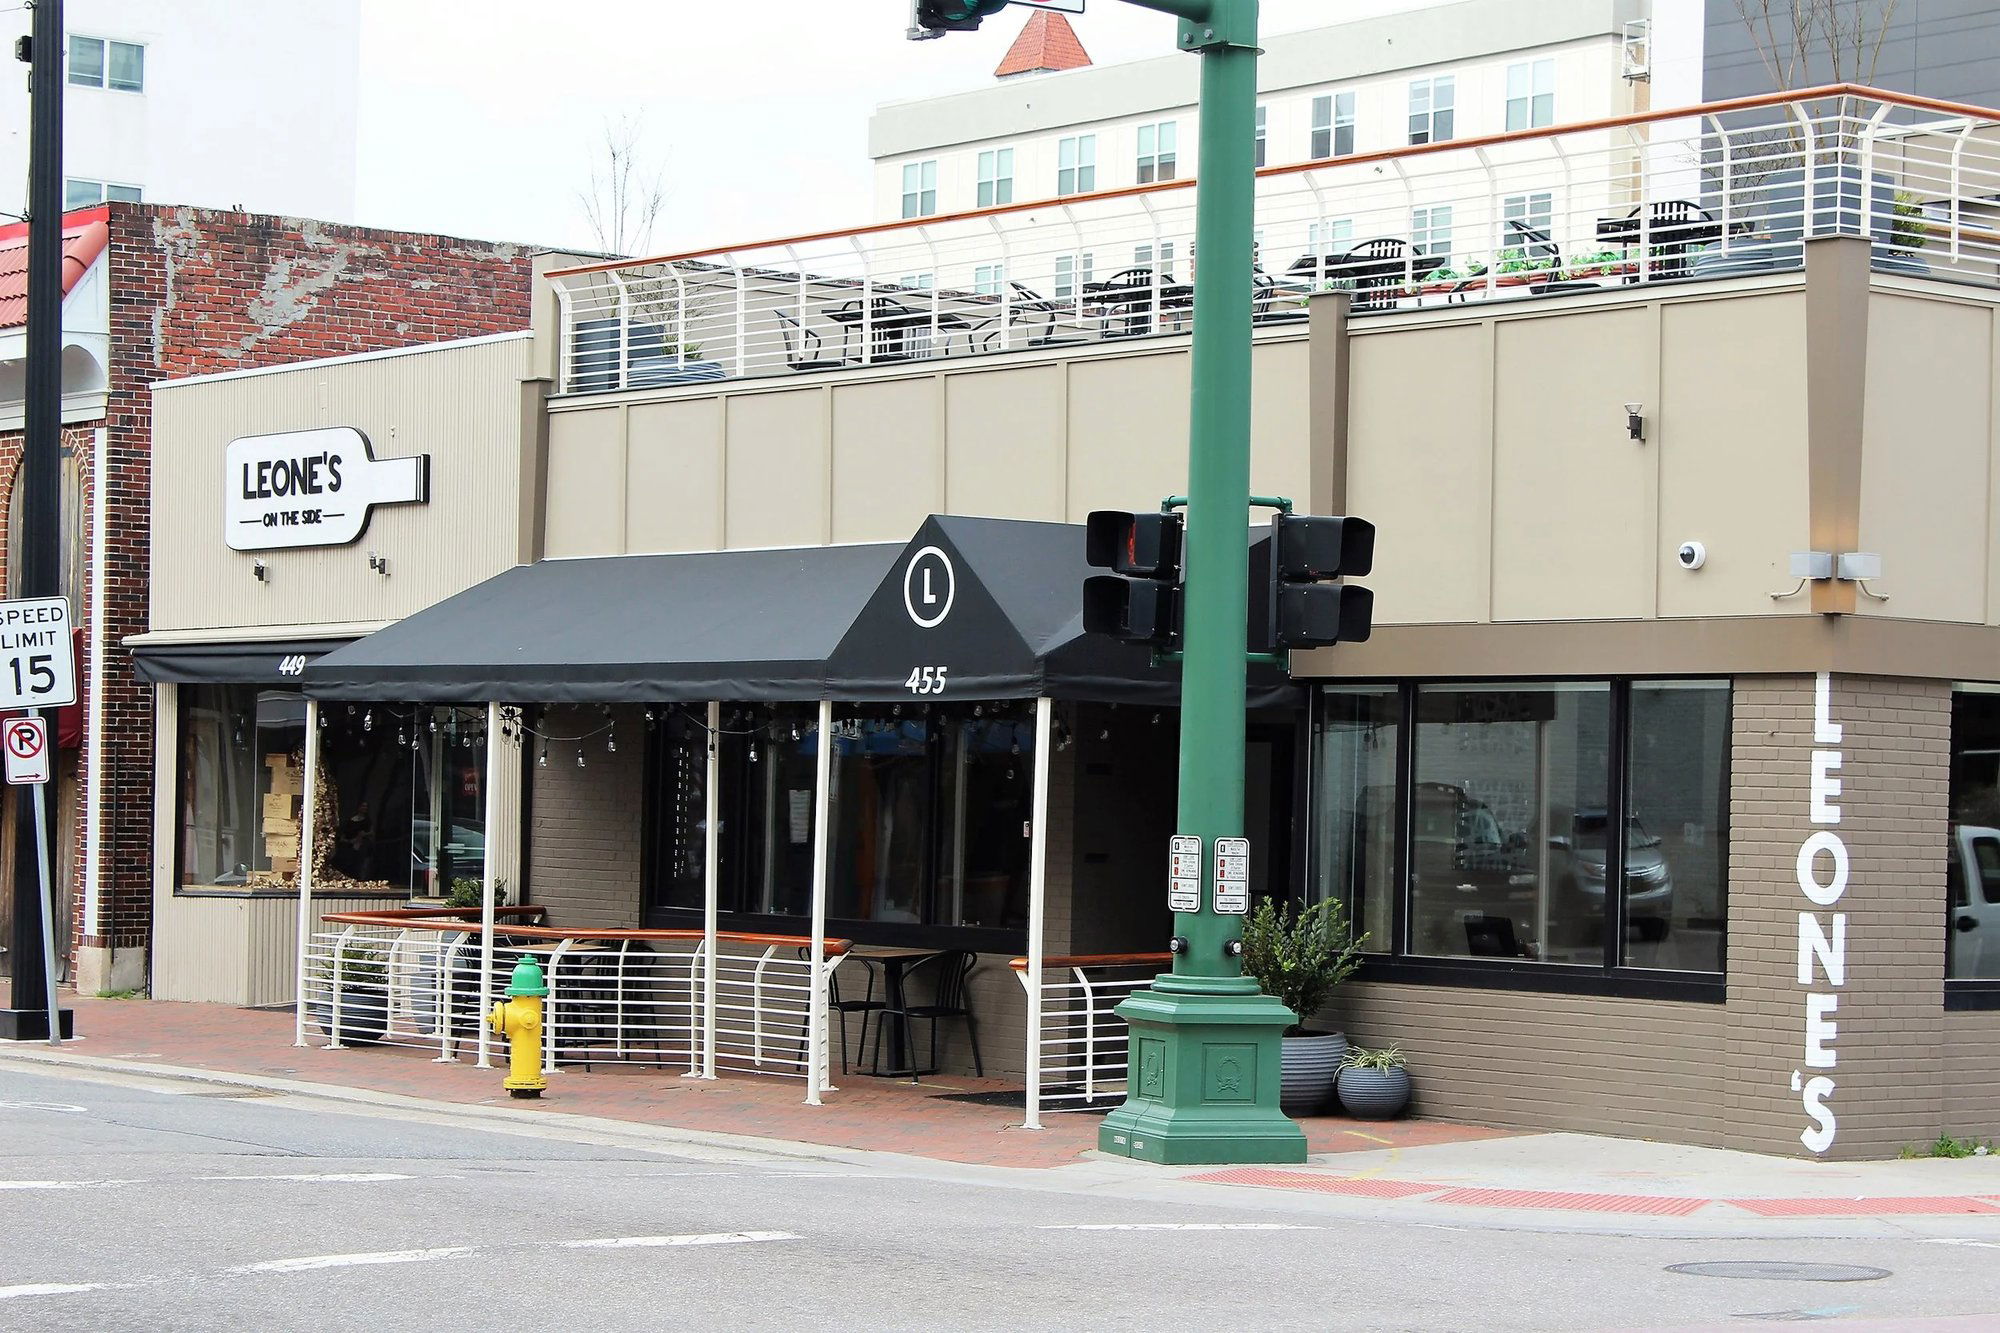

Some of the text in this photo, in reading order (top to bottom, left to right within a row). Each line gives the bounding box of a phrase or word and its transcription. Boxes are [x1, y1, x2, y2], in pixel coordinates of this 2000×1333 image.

[243, 451, 342, 499] LEONE'S
[263, 509, 322, 527] ON THE SIDE
[923, 568, 936, 604] L
[2, 631, 56, 649] LIMIT
[10, 655, 55, 695] 15
[278, 655, 306, 676] 449
[904, 666, 948, 694] 455
[1790, 672, 1849, 1153] LEONE'S
